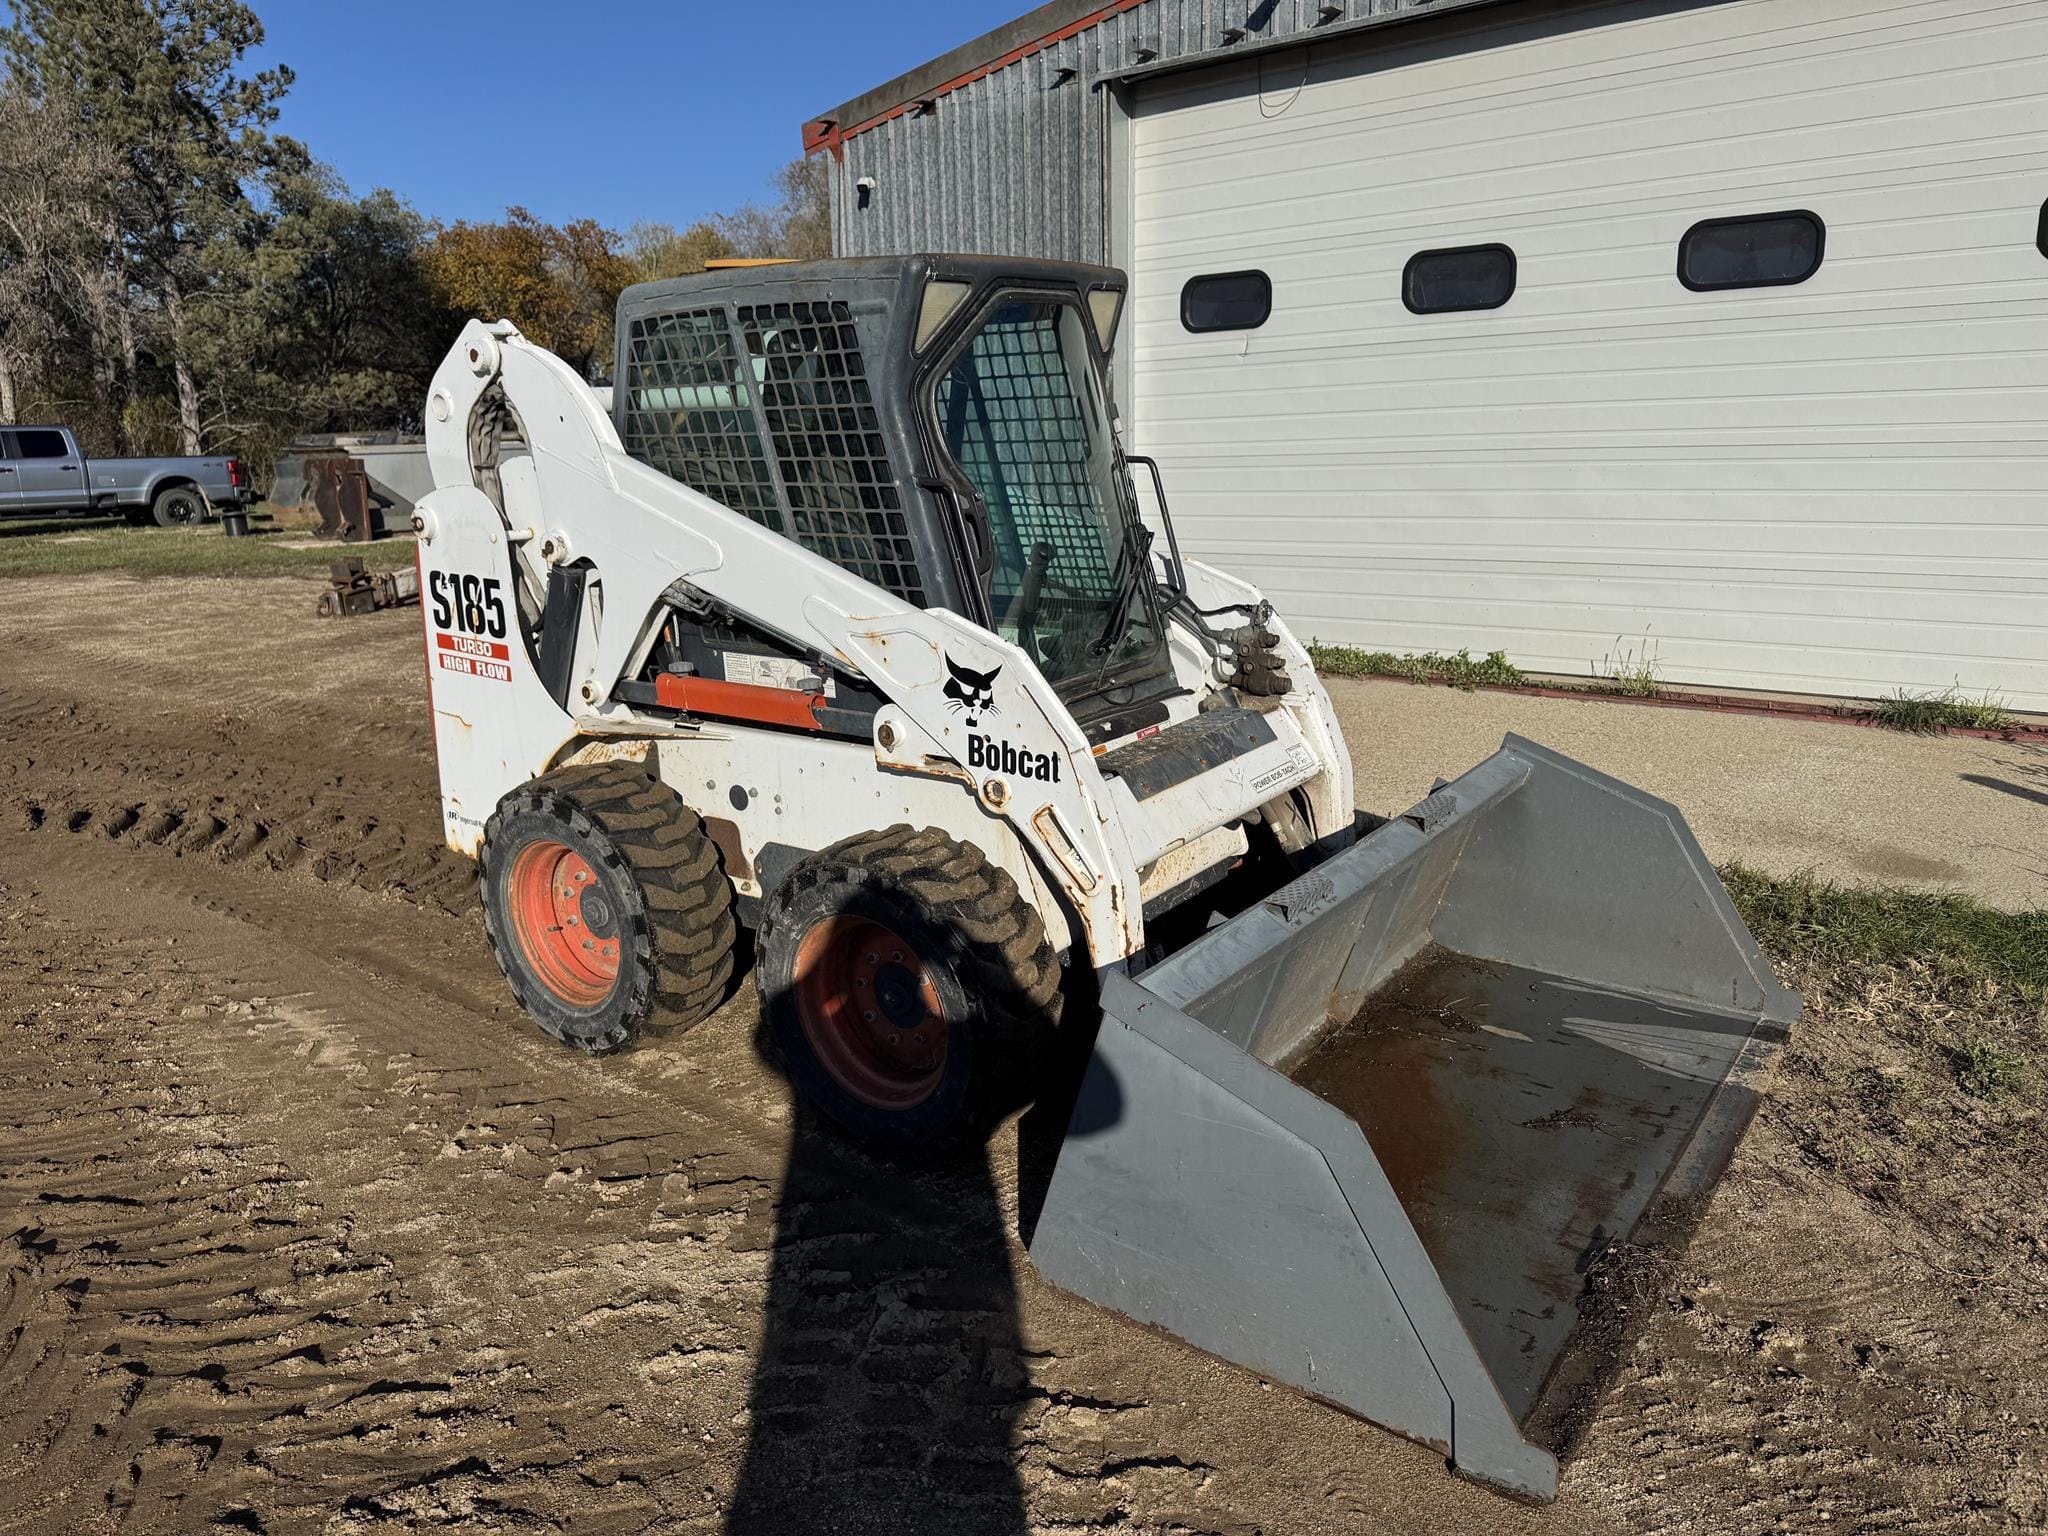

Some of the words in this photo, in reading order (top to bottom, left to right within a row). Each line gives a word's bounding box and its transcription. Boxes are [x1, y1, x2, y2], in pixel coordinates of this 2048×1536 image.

[429, 570, 507, 639] S185
[443, 655, 472, 674] HIGH
[476, 661, 508, 681] FLOW
[968, 733, 1061, 783] Bobcat
[1253, 775, 1273, 789] POWER
